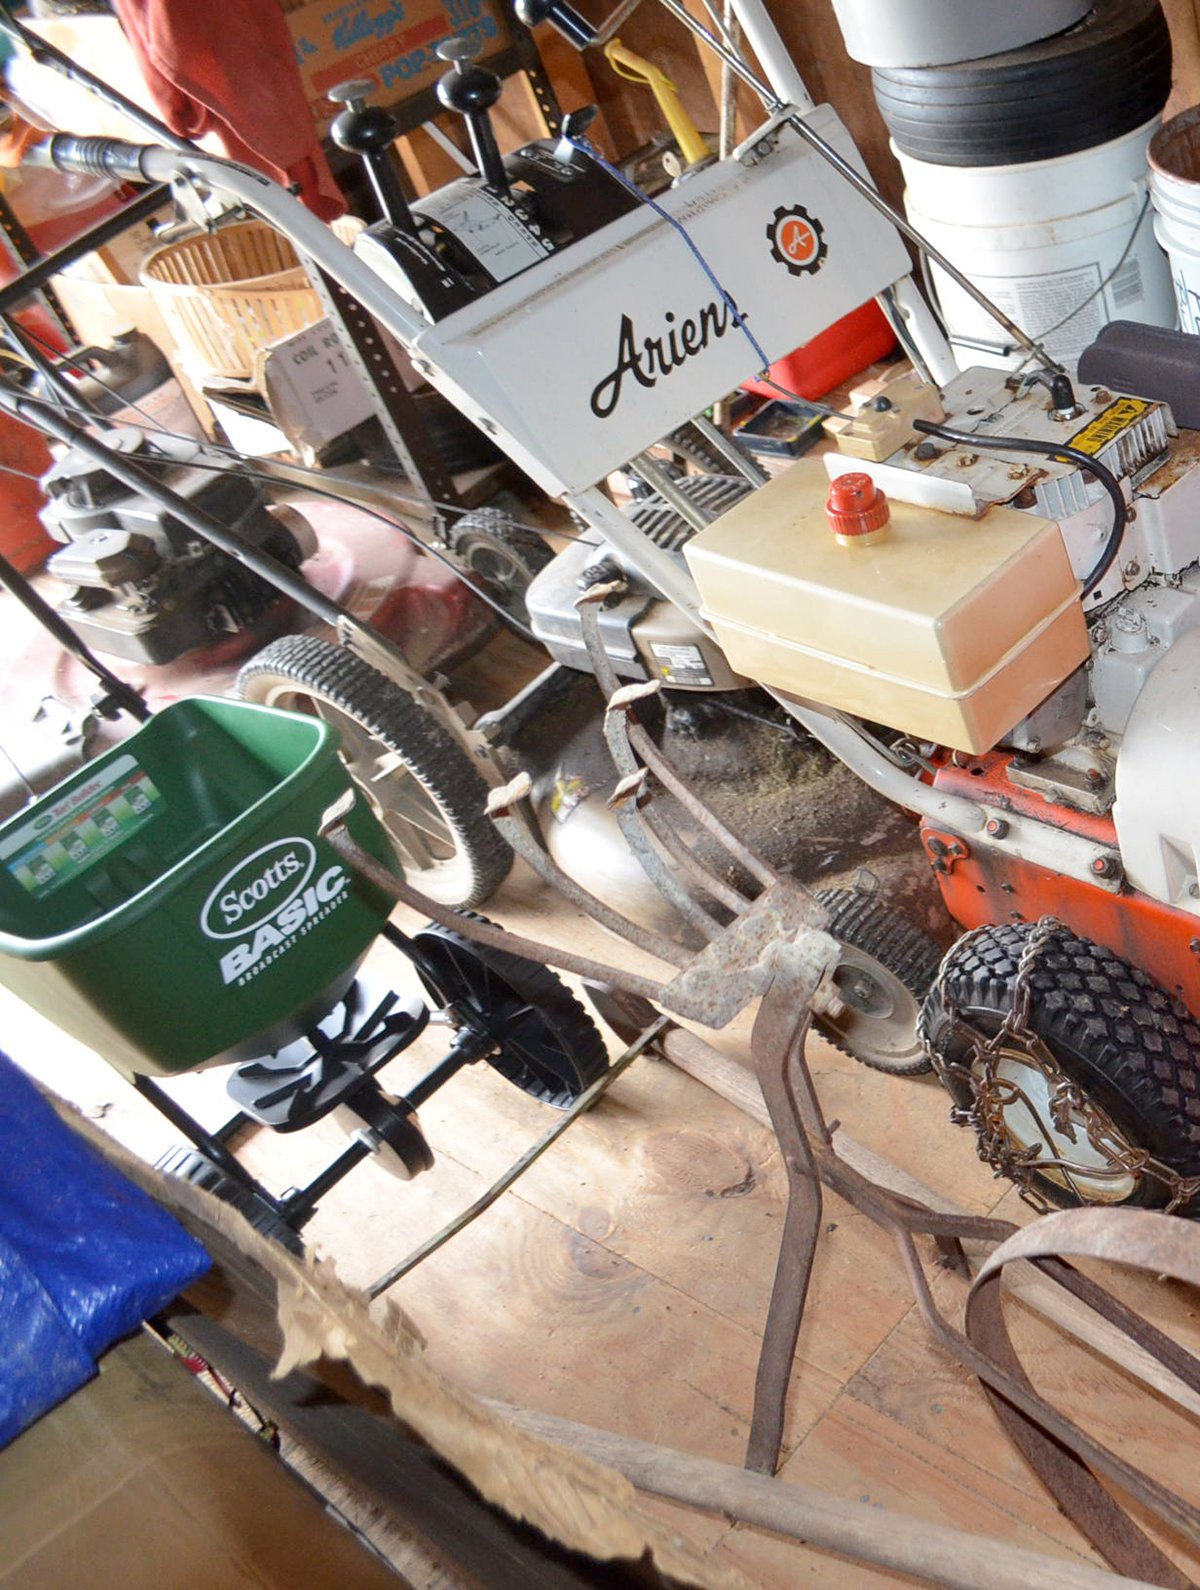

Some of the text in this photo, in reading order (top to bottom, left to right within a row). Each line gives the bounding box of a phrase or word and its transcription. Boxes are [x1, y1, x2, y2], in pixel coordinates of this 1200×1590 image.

[501, 195, 515, 207] 2
[514, 208, 529, 221] 3
[527, 224, 541, 236] 4
[541, 238, 555, 250] 5
[220, 851, 302, 925] Scotts
[219, 865, 345, 985] BASIC
[238, 890, 349, 987] BROADCAST SPREADER
